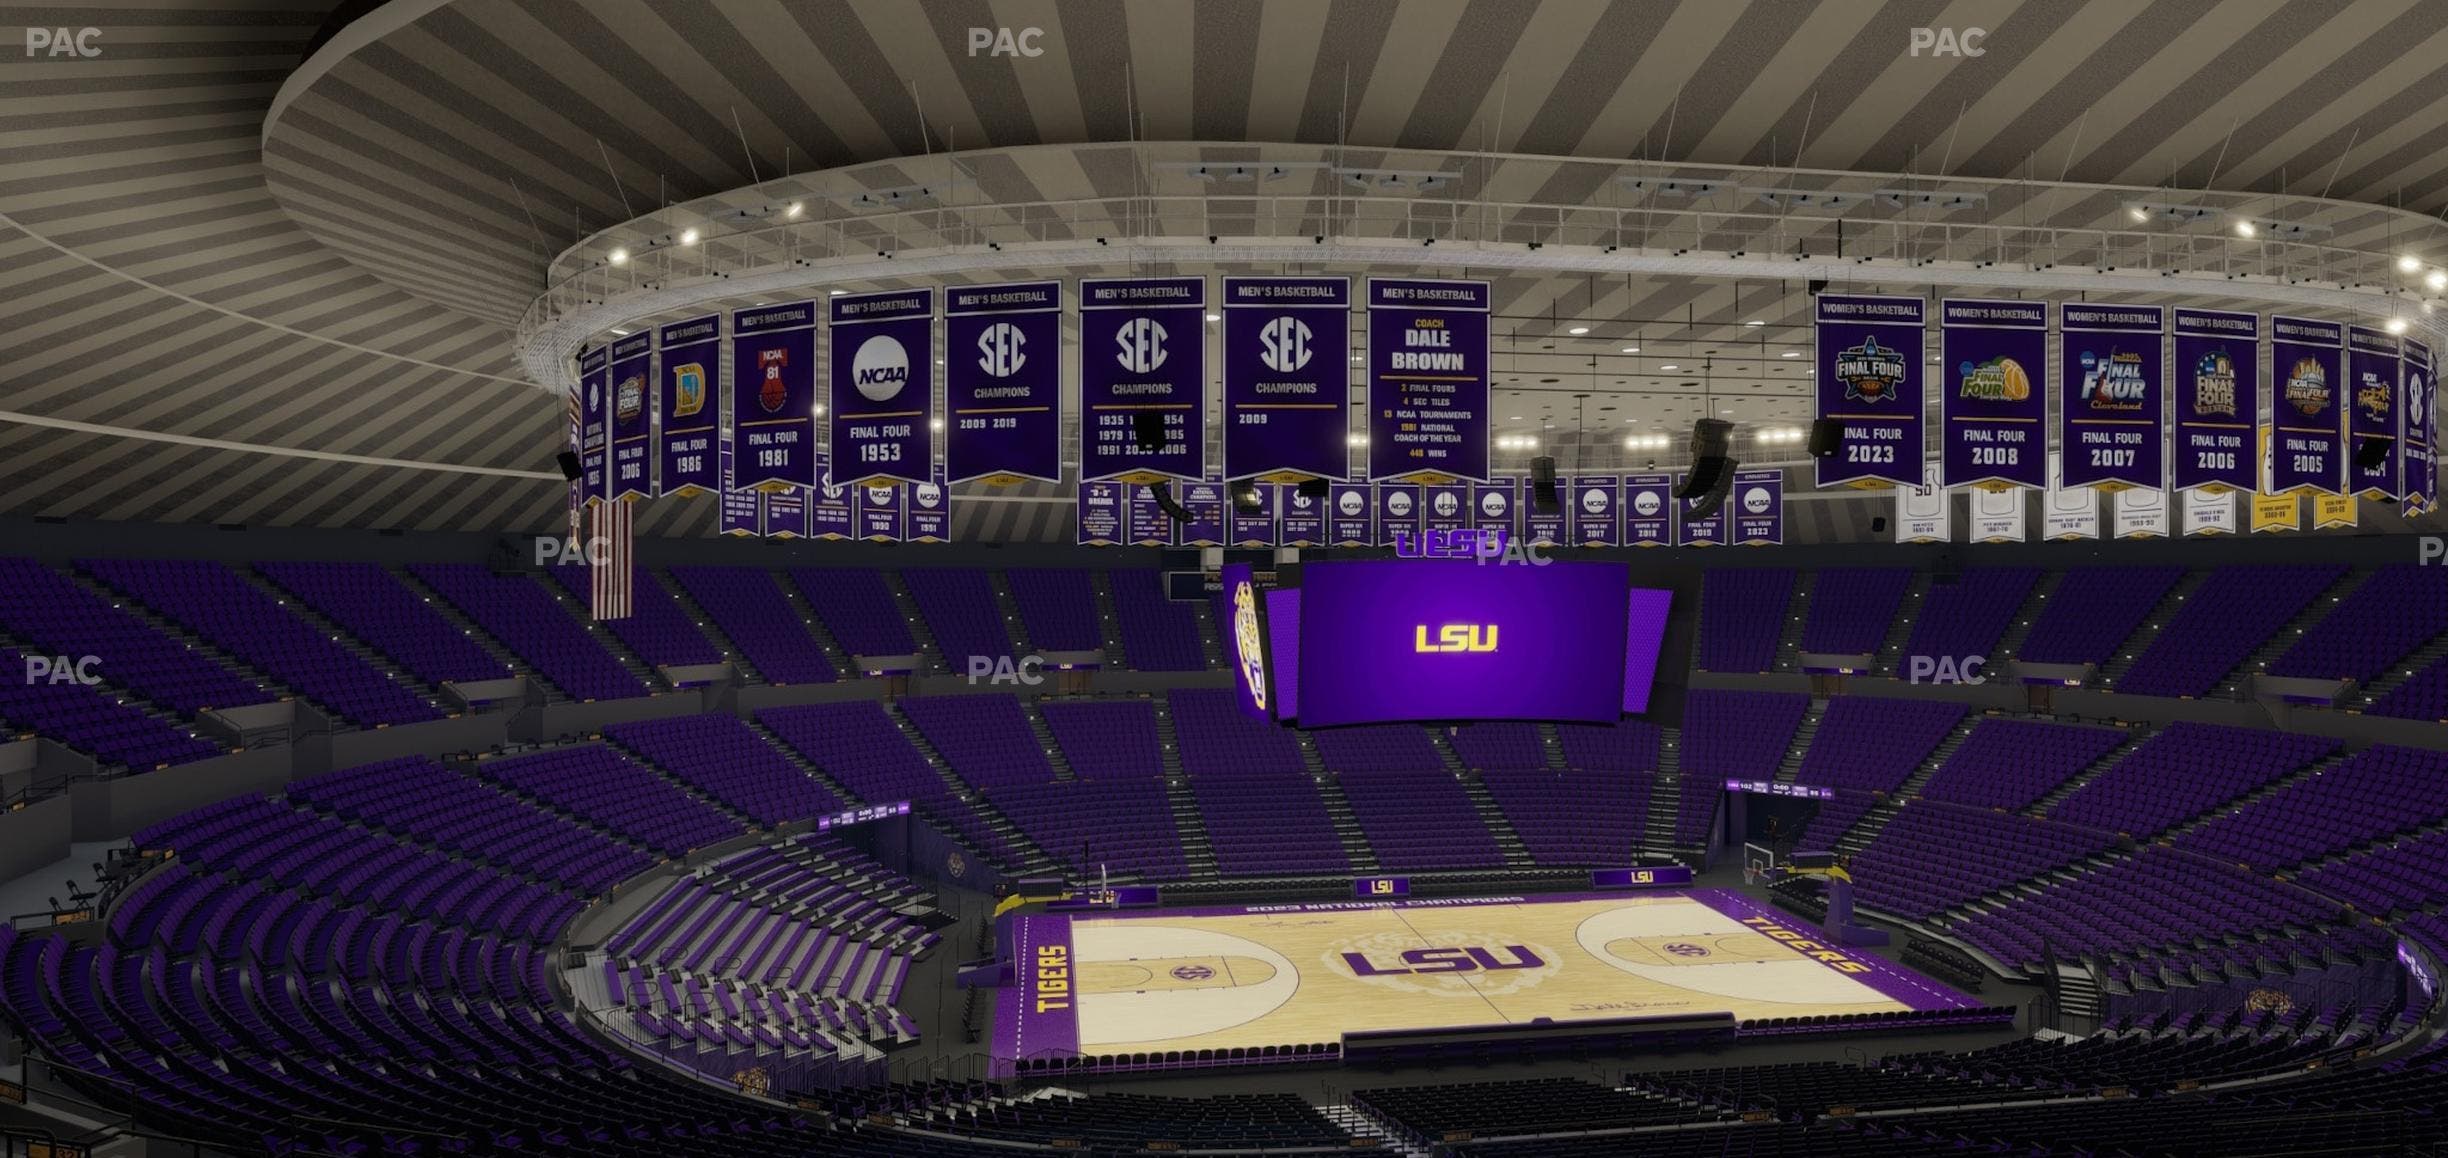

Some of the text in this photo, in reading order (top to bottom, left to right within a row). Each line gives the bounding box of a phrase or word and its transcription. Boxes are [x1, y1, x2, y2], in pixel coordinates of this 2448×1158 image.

[958, 291, 1047, 305] MEN'S BASKETBALL
[1095, 287, 1190, 299] MEN'S BASKETBALL
[1238, 286, 1335, 297] MEN'S BASKETBALL
[1383, 287, 1475, 300] MEN'S BASKETBALL
[841, 299, 920, 314] MEN'S BASKETBALL
[1822, 303, 1919, 316] WOMEN'S BASKETBALL
[1948, 307, 2041, 320] WOMEN'S BASKETBALL
[1415, 319, 1444, 328] COACH
[2067, 311, 2158, 324] WOMEN'S BASKETBALL
[1259, 316, 1313, 373] SEC
[1405, 329, 1450, 347] DALE
[978, 322, 1027, 377] SEC
[1115, 318, 1168, 374] SEC
[1391, 352, 1464, 371] BROWN
[2097, 358, 2141, 378] FINAL
[766, 365, 779, 379] 81
[859, 366, 905, 384] NCAA
[1839, 361, 1902, 378] FINAL FOUR
[974, 386, 1030, 399] CHAMPIONS
[1112, 382, 1173, 395] CHAMPIONS
[1255, 382, 1317, 394] CHAMPIONS
[1432, 384, 1456, 393] FOURS
[1961, 378, 2003, 397] FOUR
[2081, 371, 2146, 400] FUR
[1413, 397, 1427, 406] SEC
[1099, 415, 1124, 425] 1935
[1164, 414, 1184, 425] 954
[1239, 414, 1267, 425] 2009
[1396, 410, 1471, 420] NCAA TOURNAMENTS
[960, 417, 1016, 429] 2009 2019
[749, 430, 798, 446] FINAL FOUR
[850, 425, 910, 439] FINAL FOUR
[1099, 430, 1123, 441] 1979
[1165, 430, 1184, 440] 985
[1394, 434, 1418, 442] COACH
[1844, 427, 1902, 440] INAL FOUR
[1963, 429, 2025, 442] FINAL FOUR
[2082, 432, 2142, 444] FINAL FOUR
[672, 438, 707, 452] FINAL FOUR
[2191, 434, 2241, 448] FINAL FOUR
[2286, 439, 2328, 452] FINAL FOUR
[759, 448, 788, 467] 1981
[860, 443, 901, 461] 1953
[1097, 445, 1120, 456] 1991
[1847, 445, 1894, 463] 2023
[1971, 447, 2018, 465] 2008
[677, 456, 701, 473] 1986
[2091, 449, 2135, 467] 2007
[2198, 452, 2235, 469] 2006
[622, 463, 640, 480] 2006
[2293, 457, 2323, 474] 2005
[1416, 625, 1498, 652] LSU
[1631, 870, 1653, 884] LSU
[1371, 880, 1394, 894] LSU
[1246, 903, 1301, 912] 2023
[1742, 917, 1872, 973] TIGERS
[1340, 945, 1545, 976] LSU
[1037, 945, 1069, 1013] TIGERS
